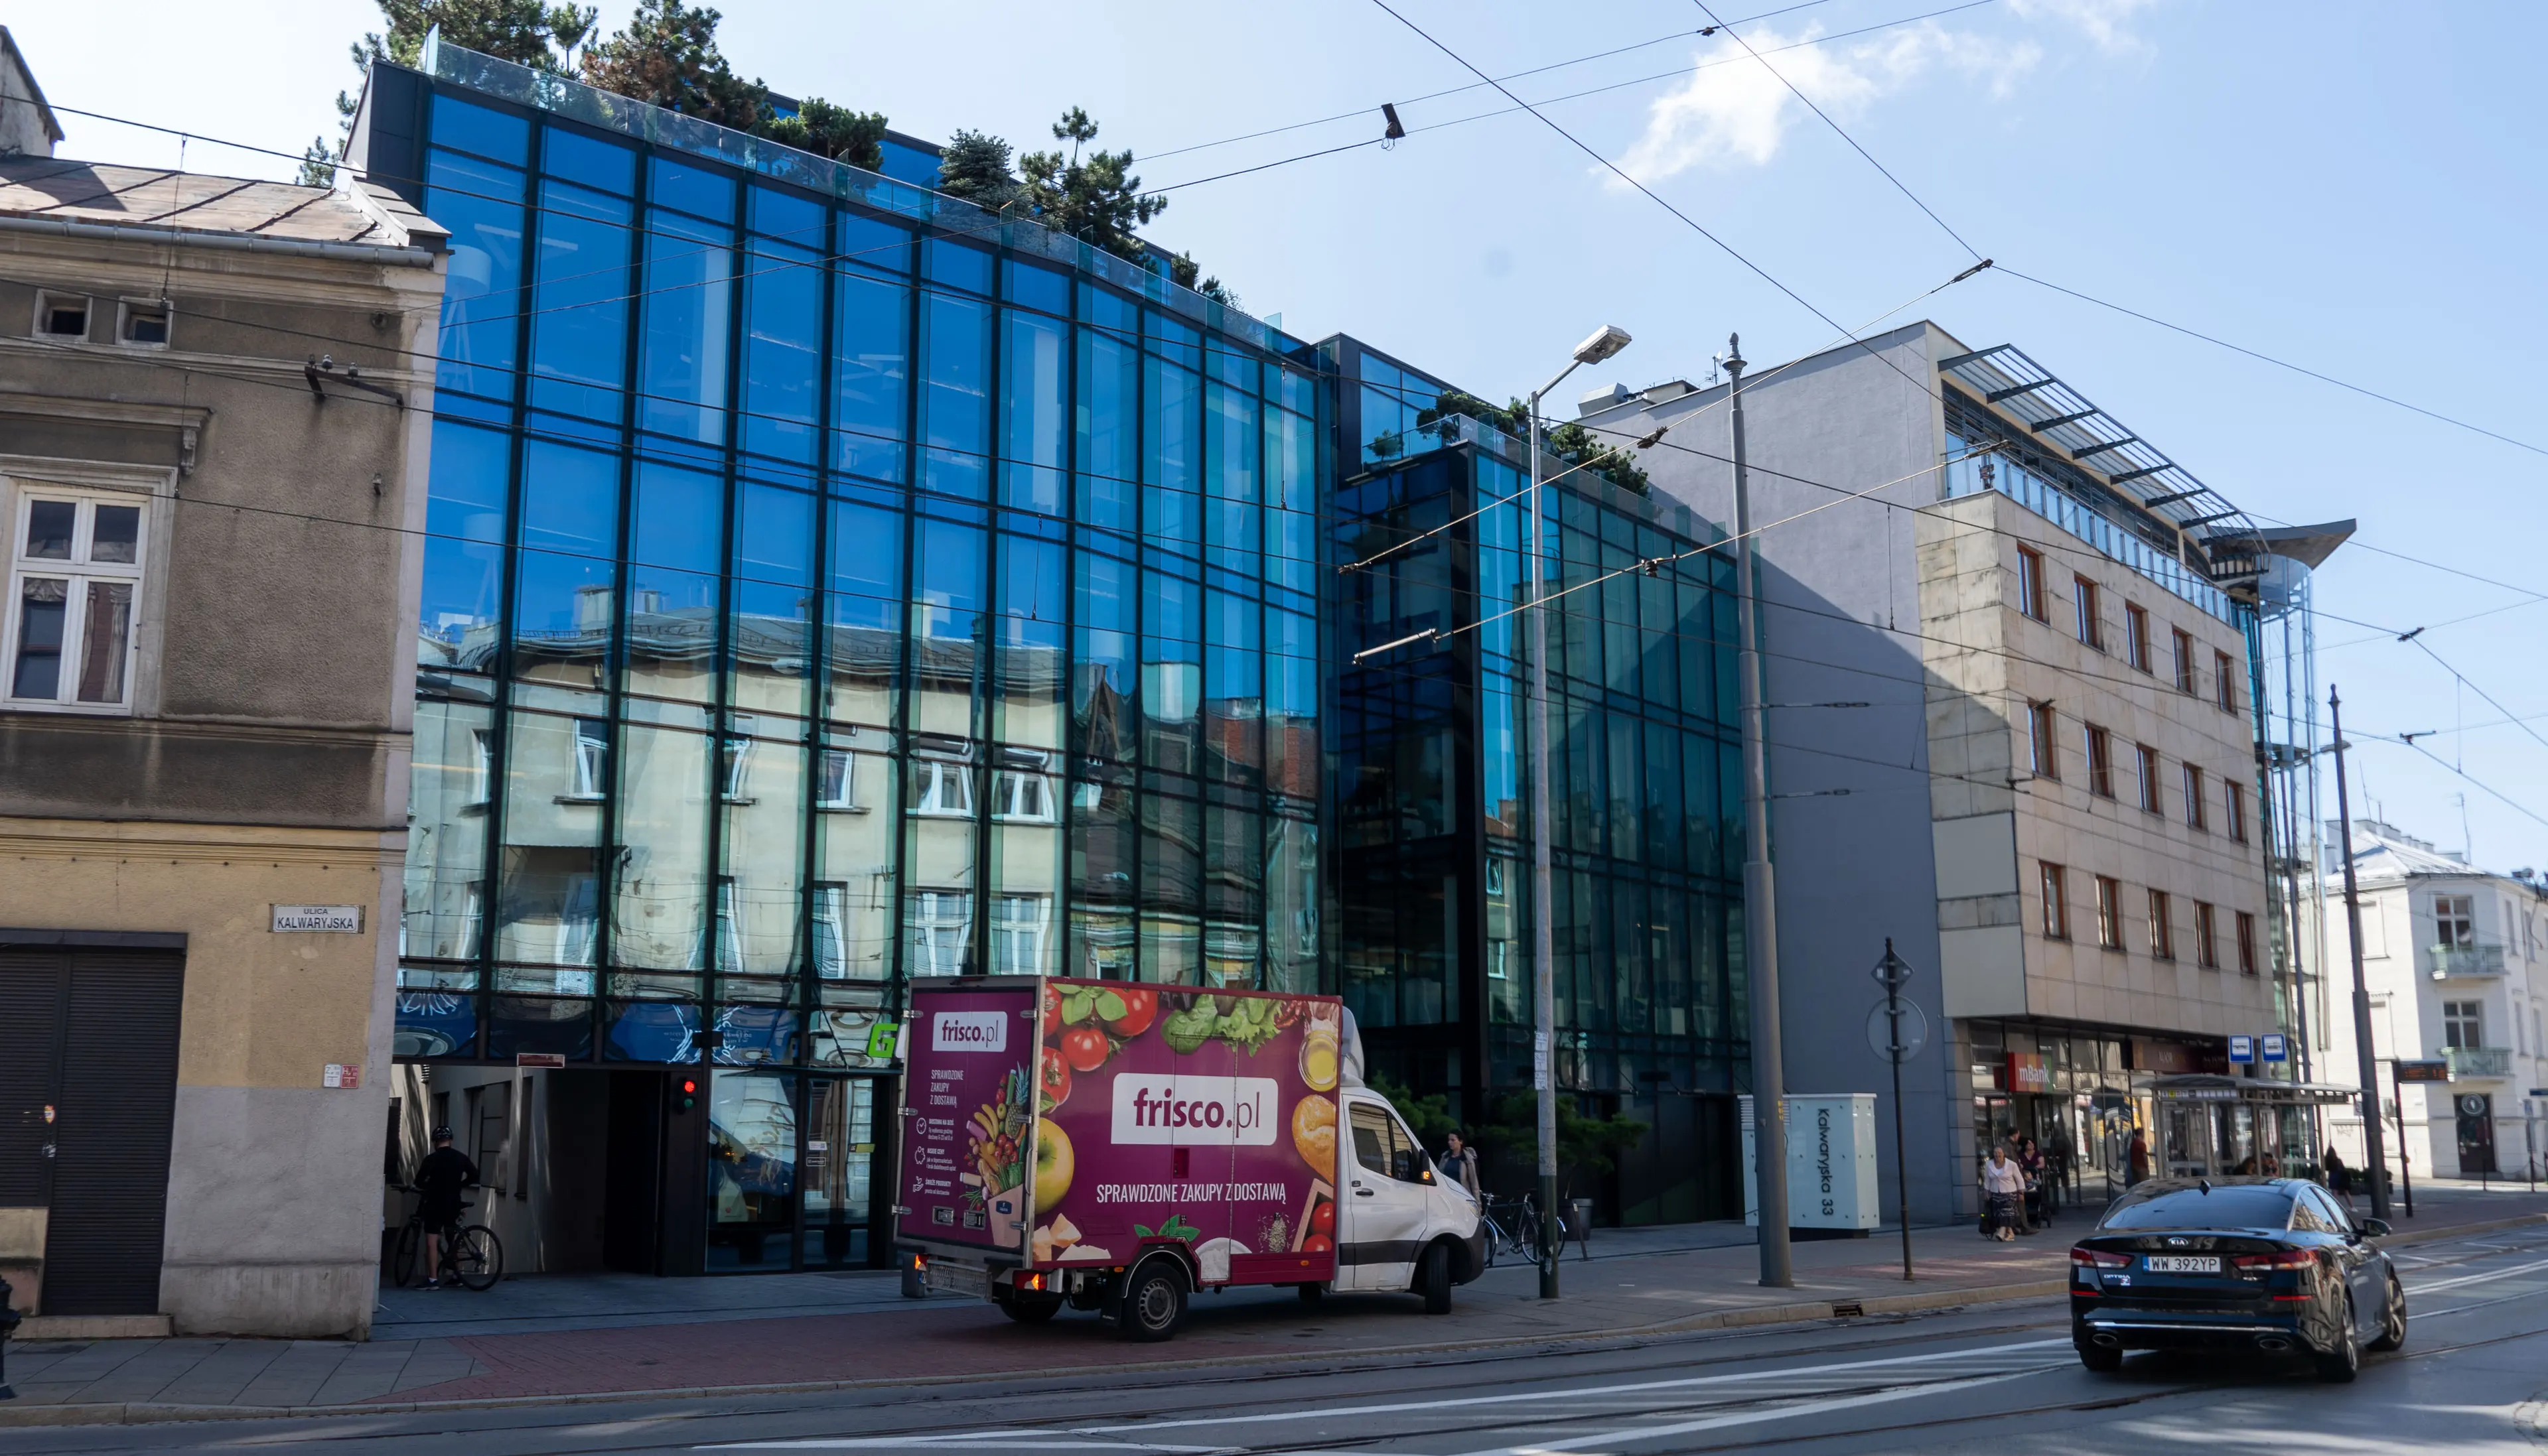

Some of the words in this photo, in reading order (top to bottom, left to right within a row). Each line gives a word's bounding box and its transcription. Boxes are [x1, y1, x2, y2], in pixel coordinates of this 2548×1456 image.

[277, 917, 354, 929] KALWARYJSKA
[942, 1020, 999, 1048] frisco.pl
[931, 1069, 964, 1081] SPRAWDZONE
[2018, 1064, 2050, 1084] mBank
[930, 1082, 950, 1092] ZAKUPY
[930, 1094, 934, 1105] Z
[934, 1094, 957, 1108] DOSTAWĄ
[1133, 1087, 1260, 1138] frisco.pl
[1817, 1108, 1833, 1193] Kalwaryjska
[1096, 1184, 1178, 1203] SPRAWDZONE
[1180, 1183, 1223, 1201] ZAKUPY
[1226, 1183, 1232, 1201] Z
[1234, 1183, 1287, 1205] DOSTAWĄ
[1821, 1199, 1834, 1217] 33
[2152, 1258, 2168, 1270] WW
[2174, 1258, 2217, 1271] 392YP
